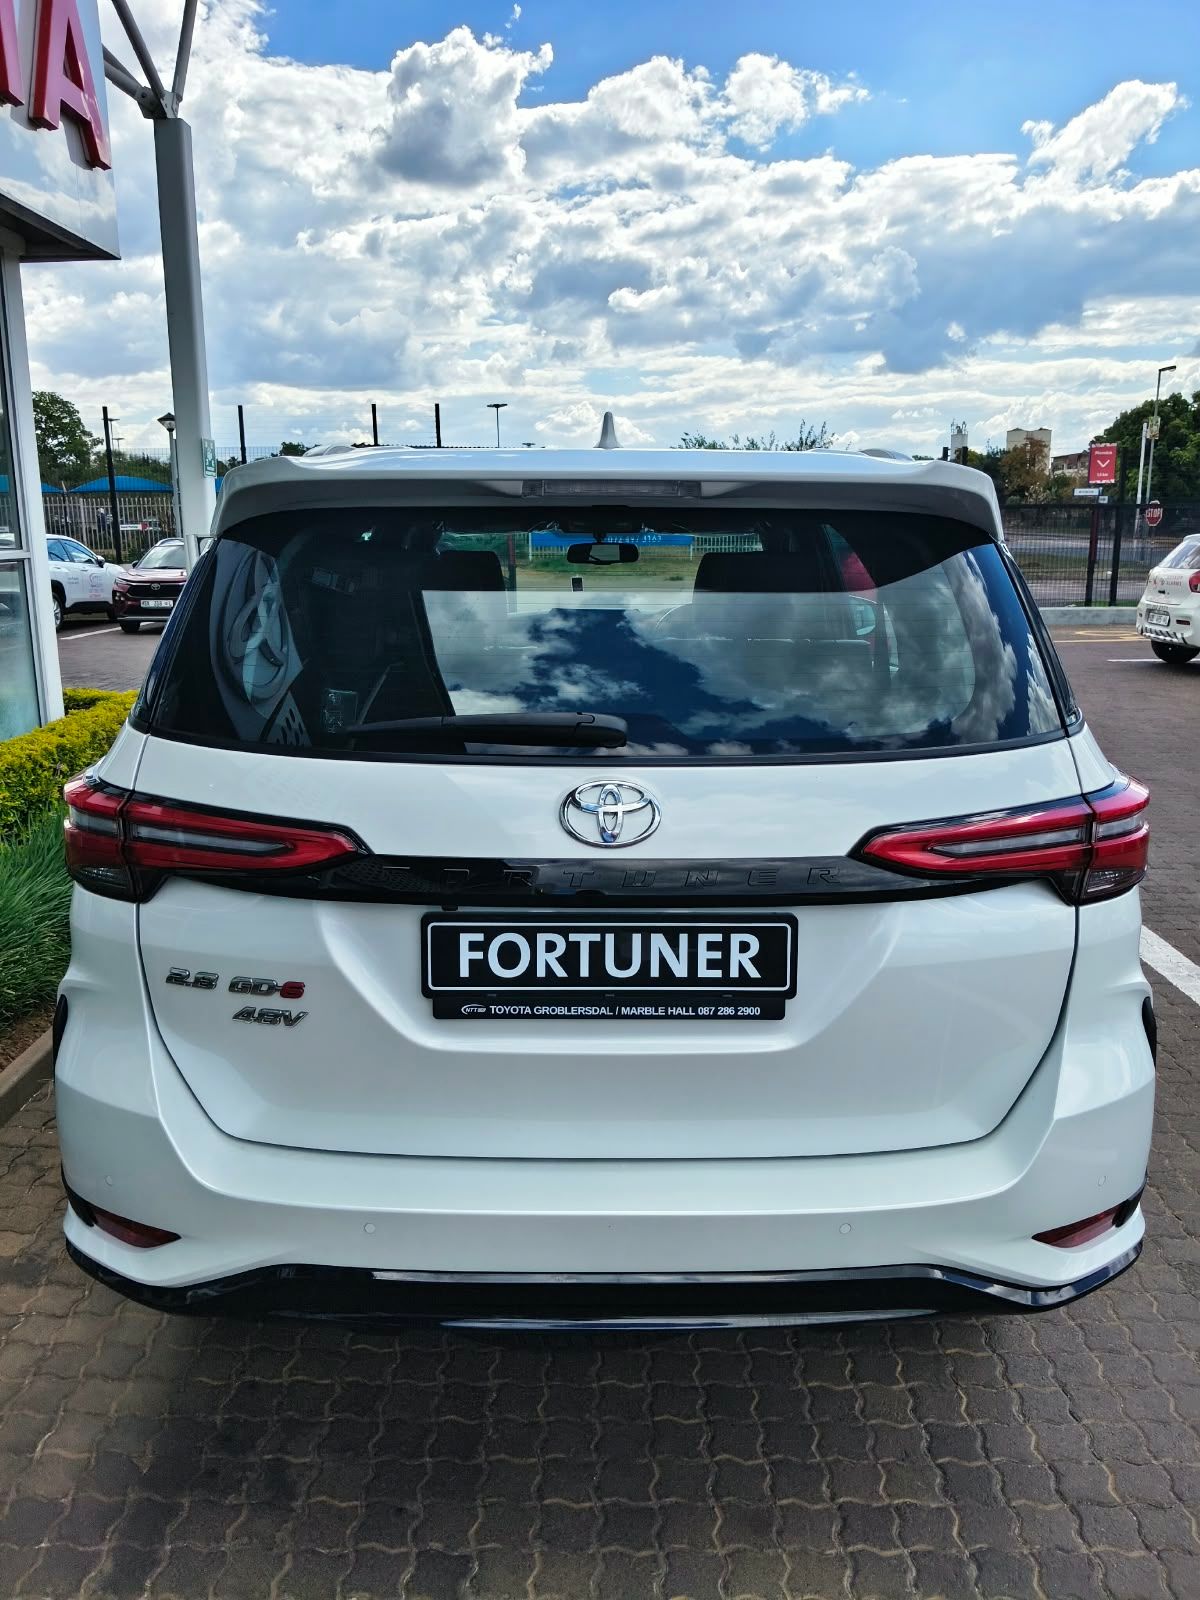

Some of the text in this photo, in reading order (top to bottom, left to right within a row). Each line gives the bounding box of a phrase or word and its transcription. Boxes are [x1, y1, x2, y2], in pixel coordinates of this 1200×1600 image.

[0, 0, 111, 170] A
[1146, 508, 1161, 517] STOP
[382, 865, 842, 889] ORTUNER
[459, 932, 762, 979] FORTUNER
[165, 966, 306, 999] 2.8 GD-6
[232, 1006, 309, 1027] 48V
[489, 1005, 532, 1015] TOYOTA
[533, 1006, 614, 1015] GROBLERSDAL
[621, 1006, 666, 1015] MARBLE
[667, 1006, 695, 1015] HALL
[697, 1006, 715, 1015] 087
[717, 1006, 735, 1015] 286
[737, 1006, 761, 1015] 2900
